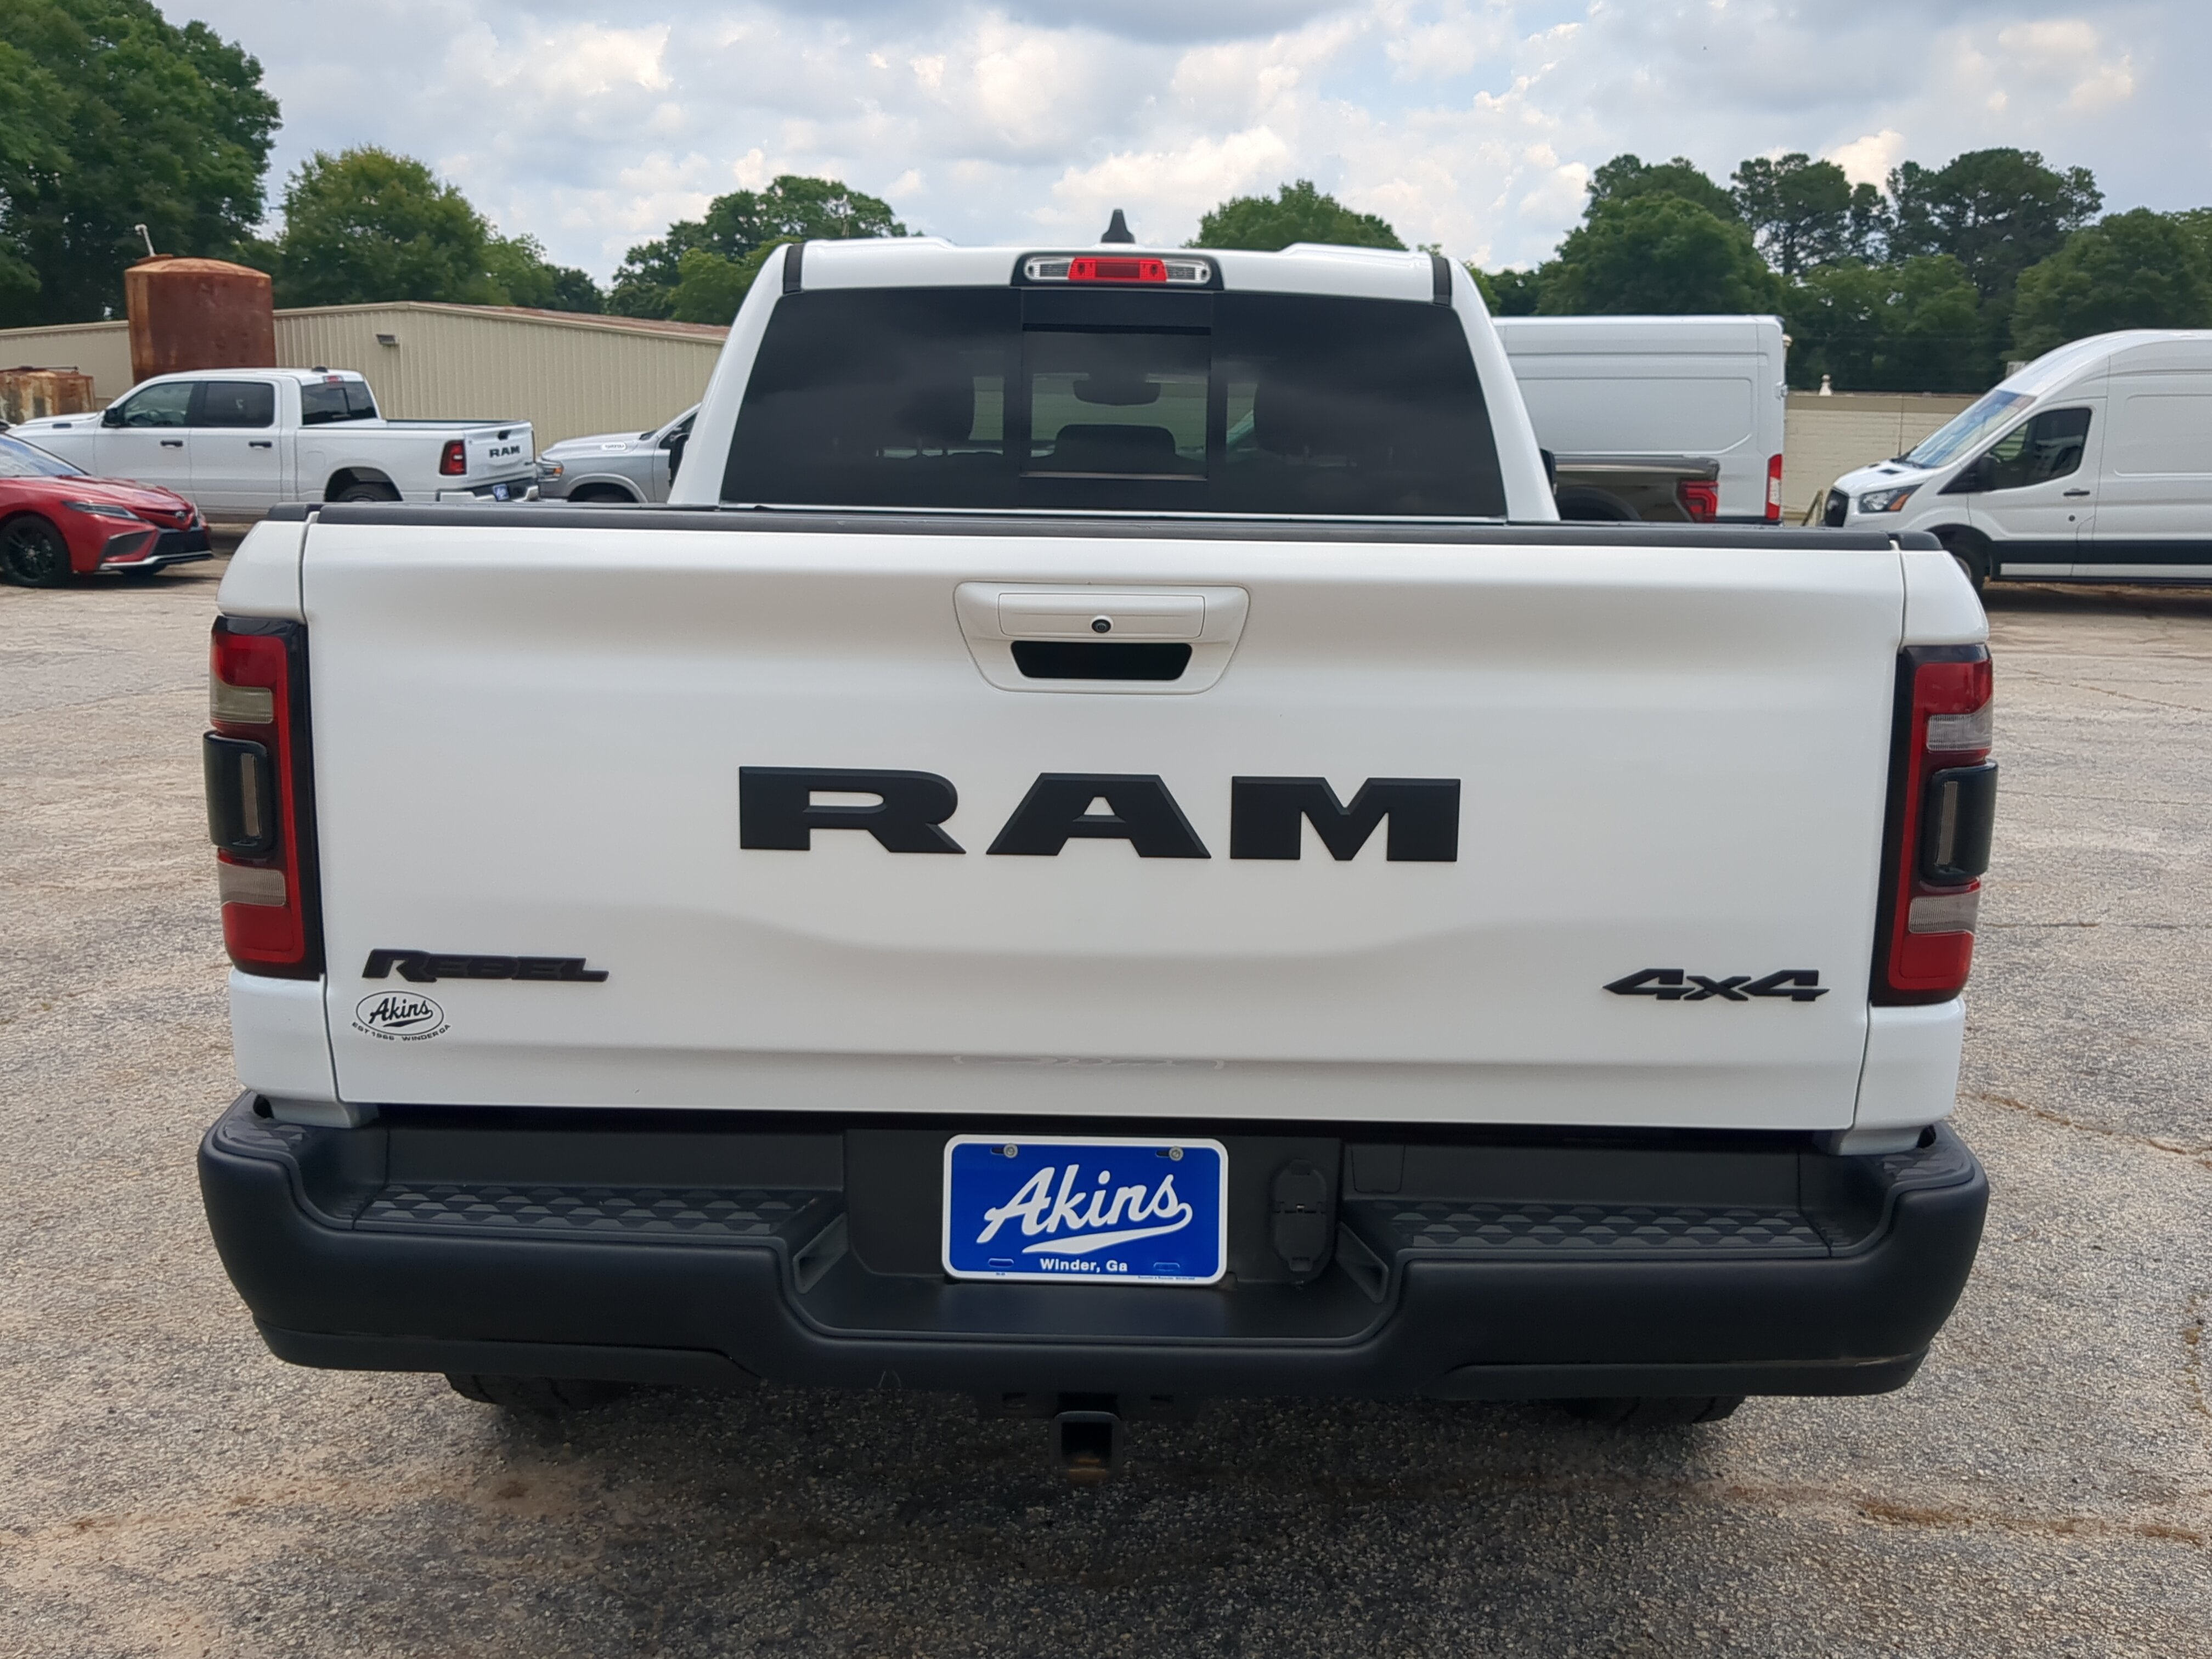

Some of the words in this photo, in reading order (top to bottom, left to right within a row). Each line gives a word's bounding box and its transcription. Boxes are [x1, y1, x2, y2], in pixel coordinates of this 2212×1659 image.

[489, 445, 520, 458] RAM
[739, 766, 1461, 861] RAM
[1602, 968, 1831, 1002] 4x4
[368, 996, 433, 1024] Akins
[352, 1021, 370, 1034] EST
[976, 1164, 1193, 1244] Akins
[1040, 1258, 1101, 1273] Winder,
[1105, 1260, 1128, 1272] Ga
